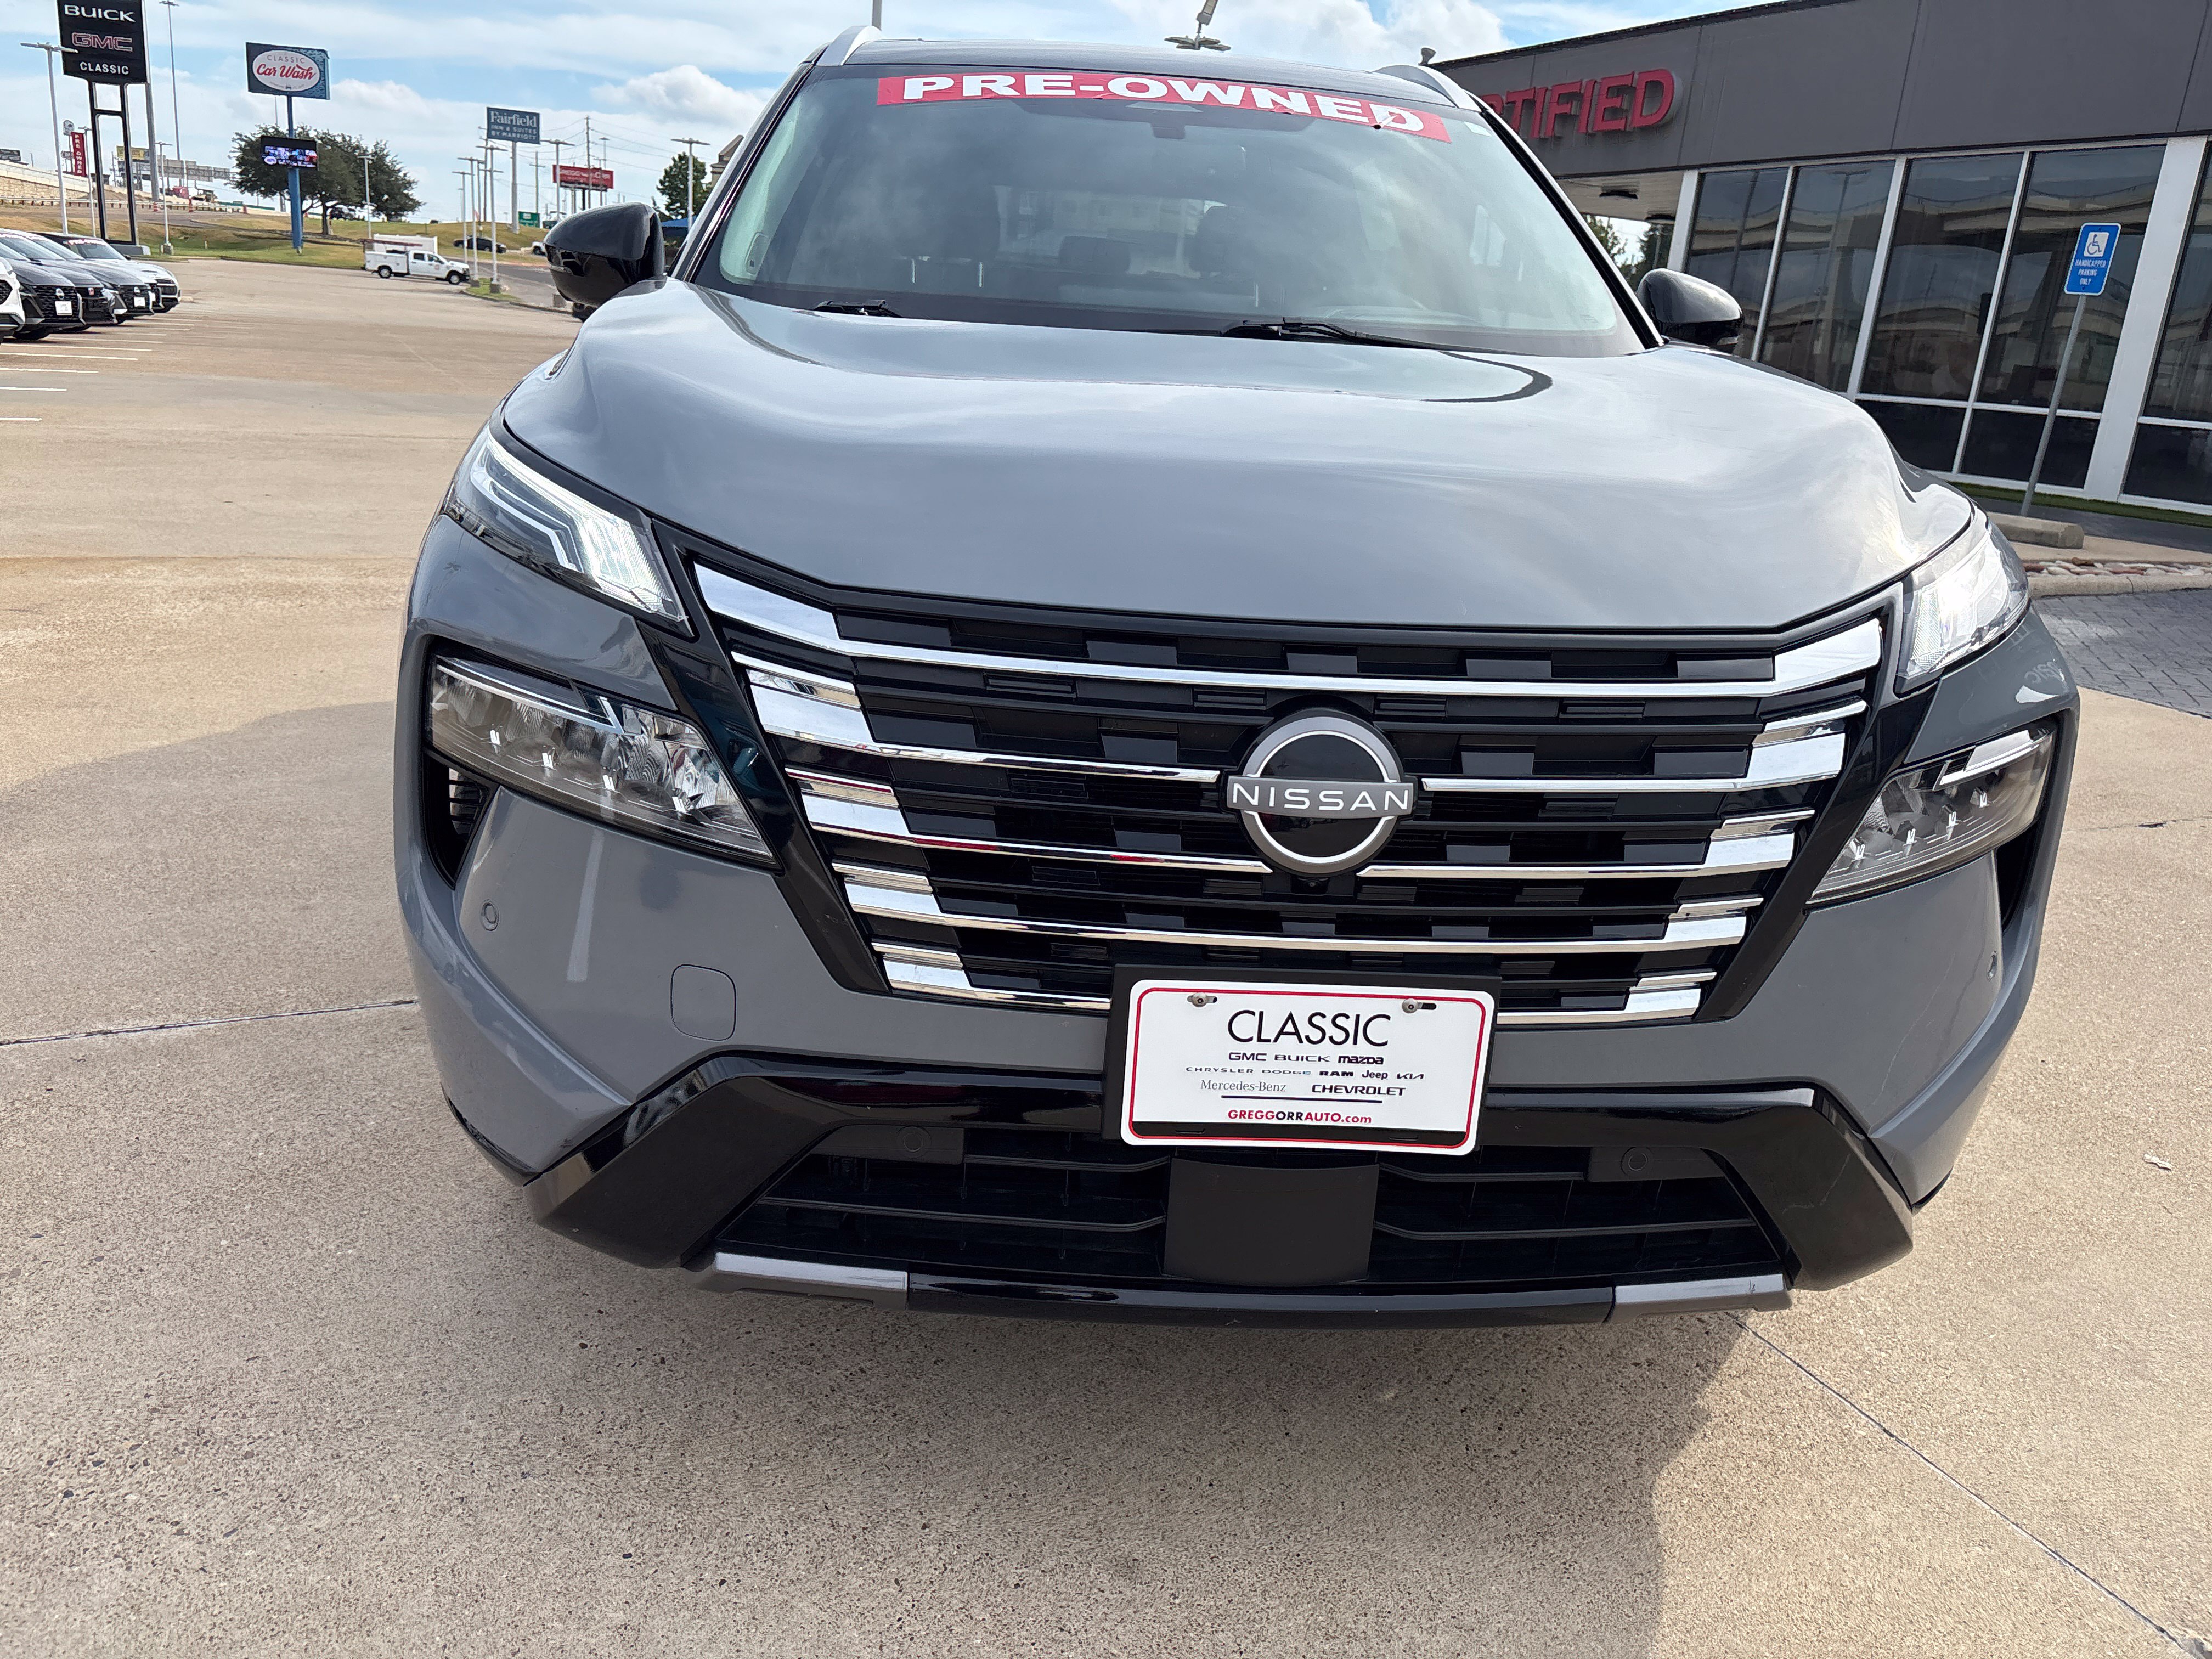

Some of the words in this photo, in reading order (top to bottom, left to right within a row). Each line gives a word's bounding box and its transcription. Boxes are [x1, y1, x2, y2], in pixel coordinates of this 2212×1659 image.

[64, 4, 136, 23] BUICK
[72, 32, 133, 52] GMC
[267, 54, 306, 64] CLASSIC
[80, 61, 129, 75] CLASSIC
[257, 63, 277, 77] Car
[279, 64, 316, 80] Wash
[904, 74, 1424, 132] PRE-OWNED
[1480, 69, 1675, 138] TIFIED
[490, 111, 537, 128] Fairfield
[2075, 259, 2107, 268] HANDICAPPED
[1232, 783, 1409, 811] NISSAN
[1227, 1009, 1391, 1047] CLASSIC
[1228, 1052, 1267, 1062] GMC
[1274, 1054, 1330, 1063] BUICK
[1362, 1070, 1388, 1080] Jeep
[1200, 1080, 1286, 1092] Mercedes-Benz
[1312, 1084, 1407, 1096] CHEVROLET
[1228, 1109, 1372, 1123] GREGGORRAUTO.com
